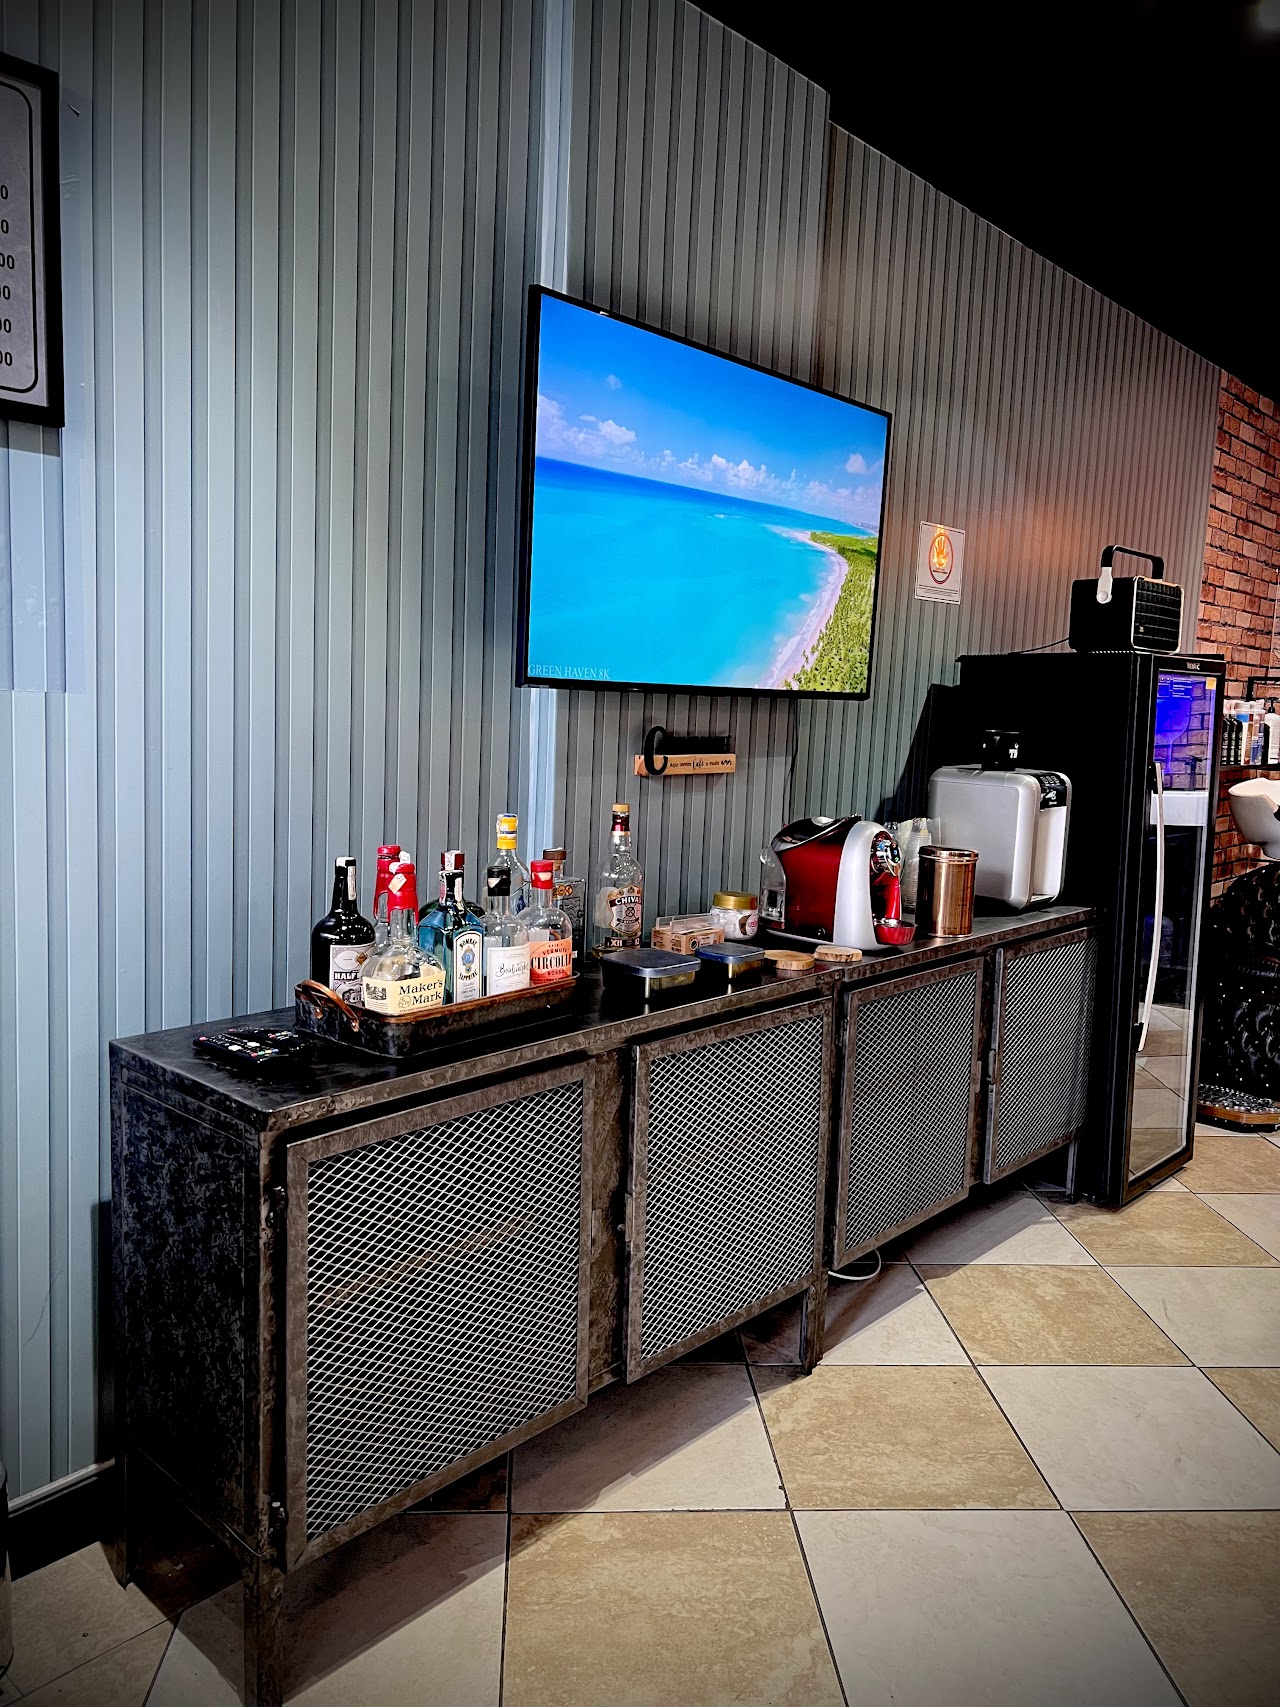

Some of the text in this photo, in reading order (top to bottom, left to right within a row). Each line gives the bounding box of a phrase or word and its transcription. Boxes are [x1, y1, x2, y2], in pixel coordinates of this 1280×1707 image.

[528, 664, 610, 680] GREEN HAVEN 8K
[397, 979, 443, 995] Maker's
[411, 991, 442, 1006] Mark
